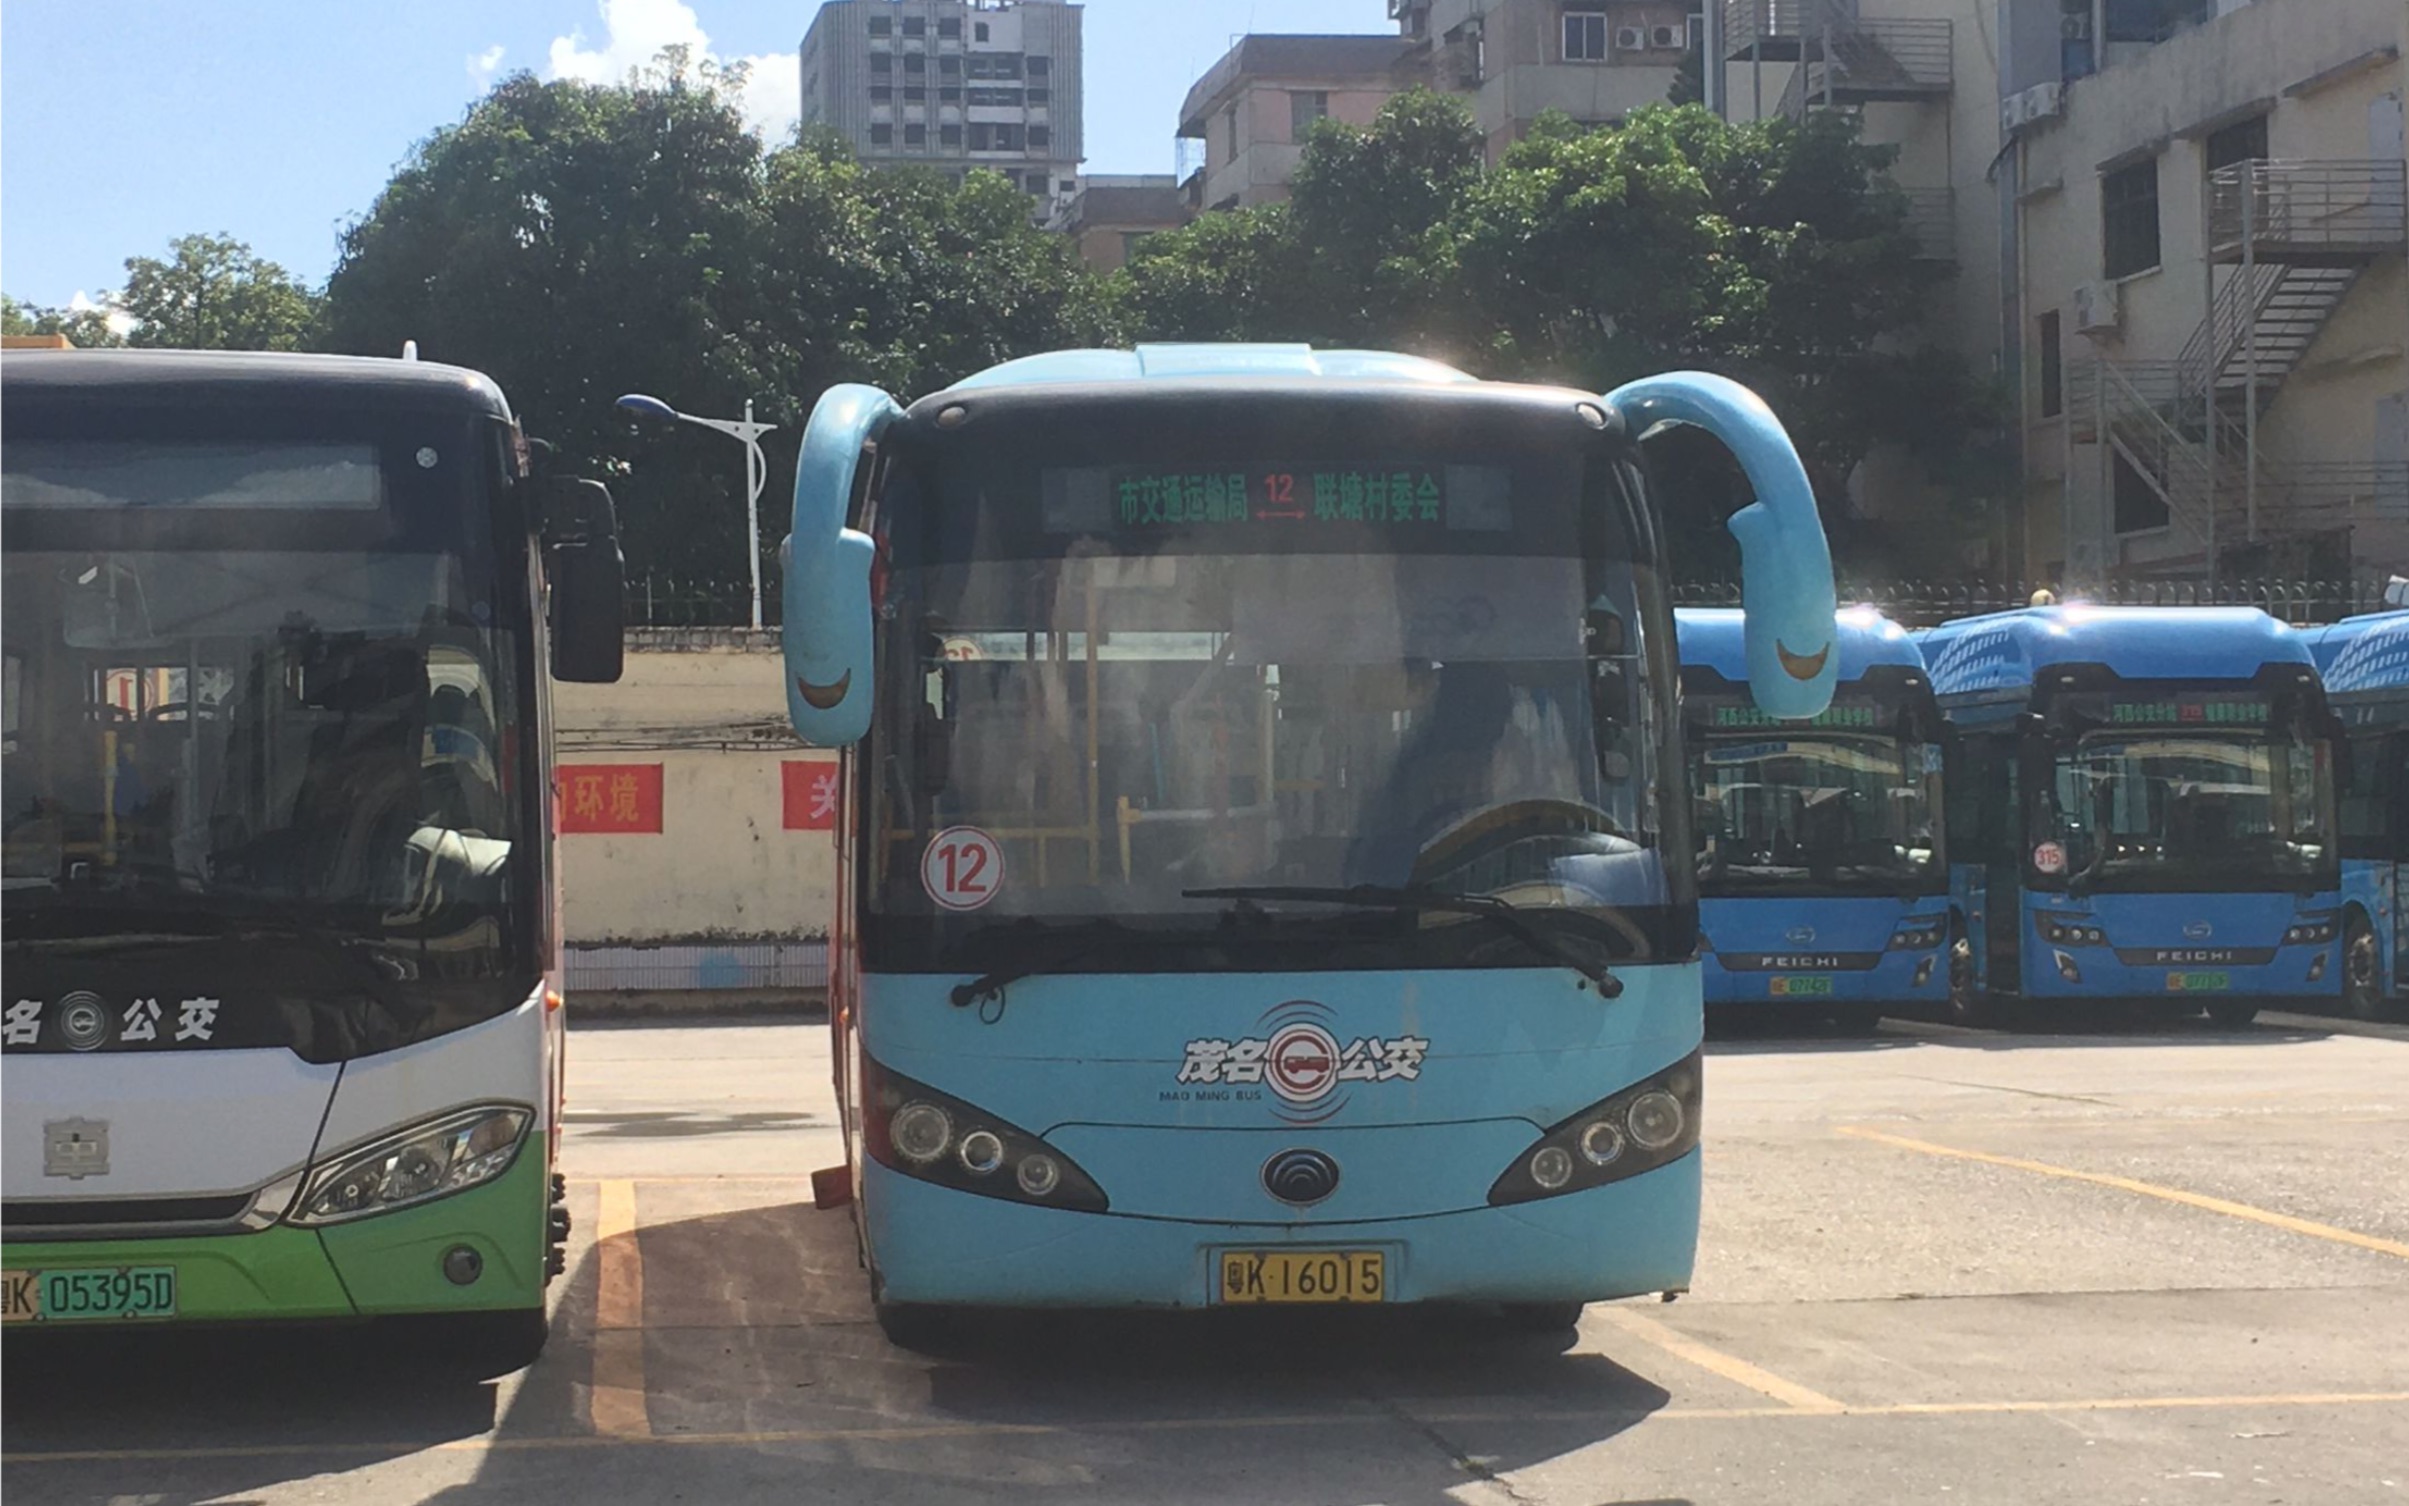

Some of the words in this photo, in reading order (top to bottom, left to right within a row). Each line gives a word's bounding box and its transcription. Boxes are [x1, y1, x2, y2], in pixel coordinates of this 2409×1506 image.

[1118, 473, 1249, 524] 市交通运输局
[1264, 474, 1294, 503] 12
[1313, 472, 1439, 522] 联塘村委会
[936, 842, 988, 892] 12
[2037, 848, 2060, 865] 315
[1762, 956, 1839, 967] FEICHI
[2156, 950, 2232, 962] FEICHI
[2, 999, 43, 1045] 名
[119, 996, 221, 1042] 公交
[1176, 1037, 1270, 1084] 茂名
[1337, 1035, 1431, 1083] 公交
[1159, 1091, 1190, 1101] MAO
[1236, 1090, 1262, 1101] BUS
